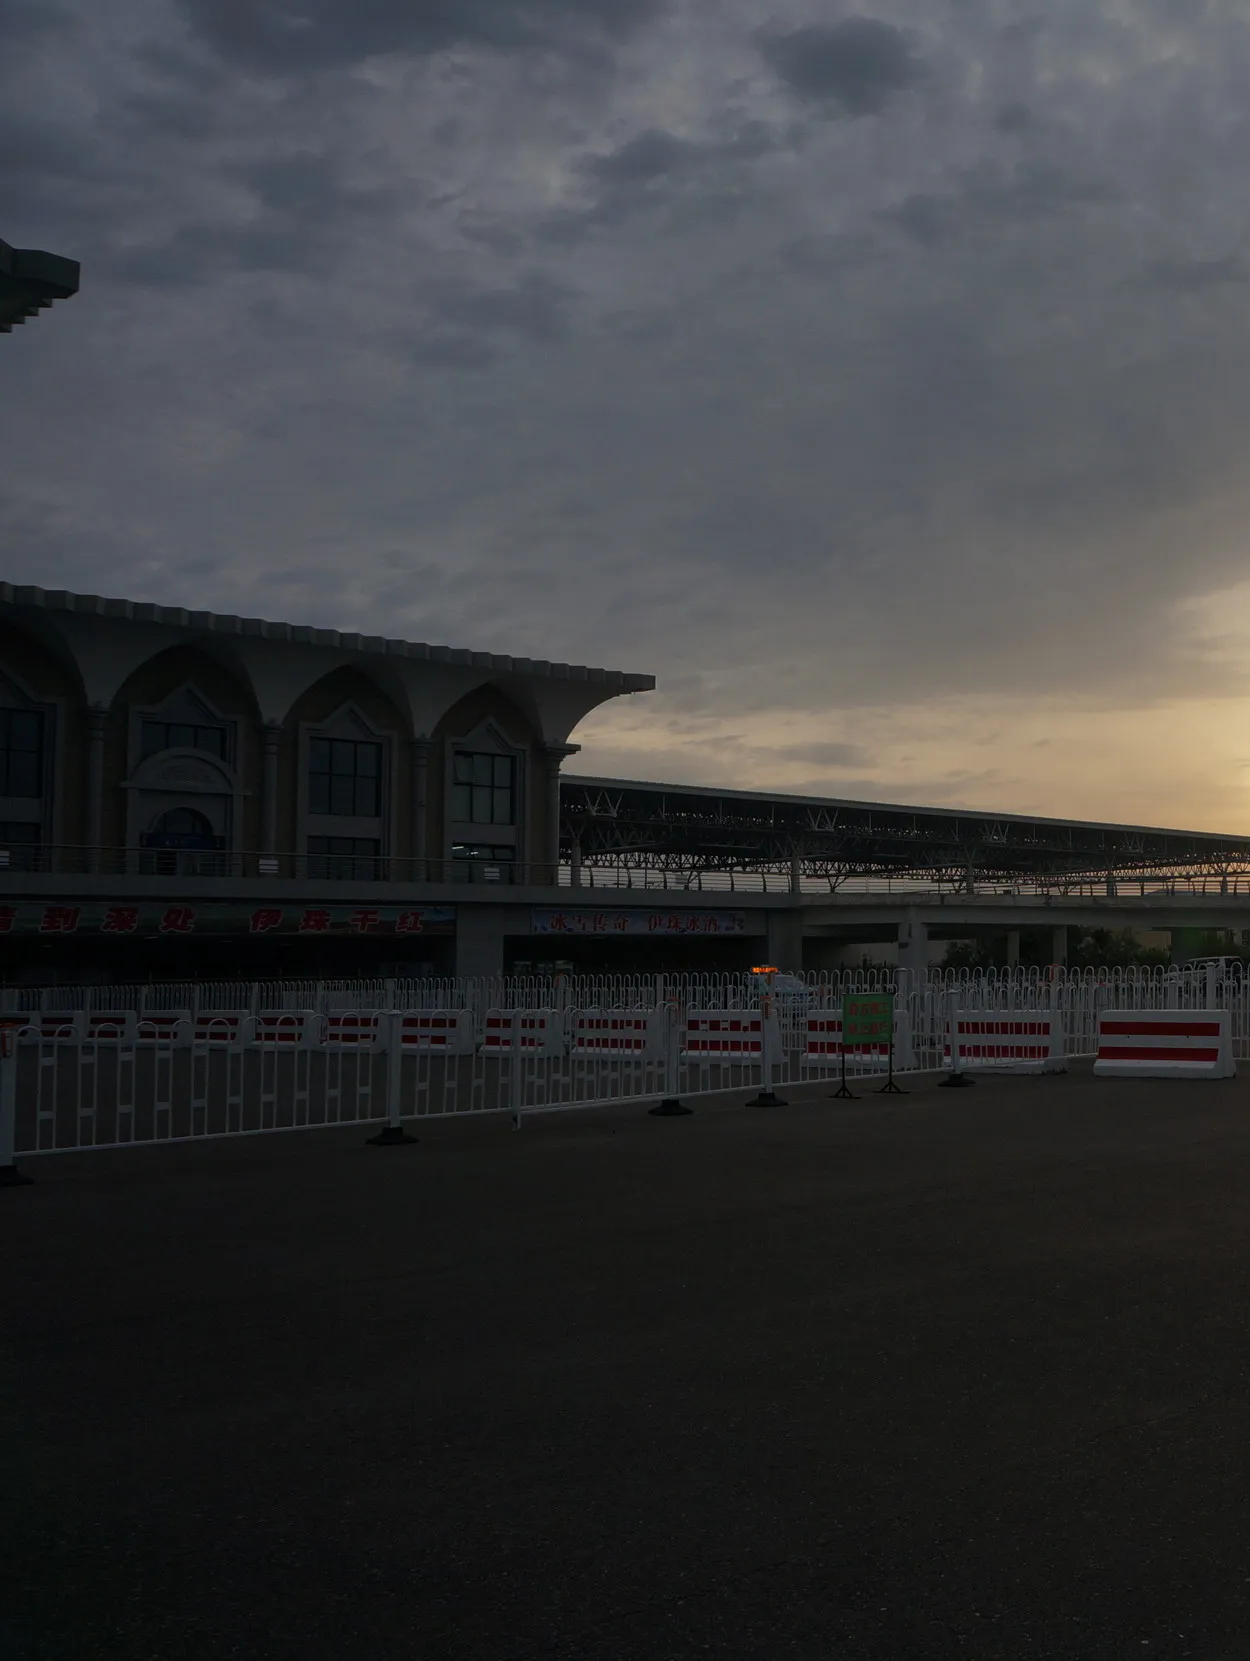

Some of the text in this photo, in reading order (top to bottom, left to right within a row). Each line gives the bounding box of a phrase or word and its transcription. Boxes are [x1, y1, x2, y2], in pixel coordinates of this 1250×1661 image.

[250, 908, 423, 933] 伊珠干红
[550, 913, 629, 931] 冰雪传奇
